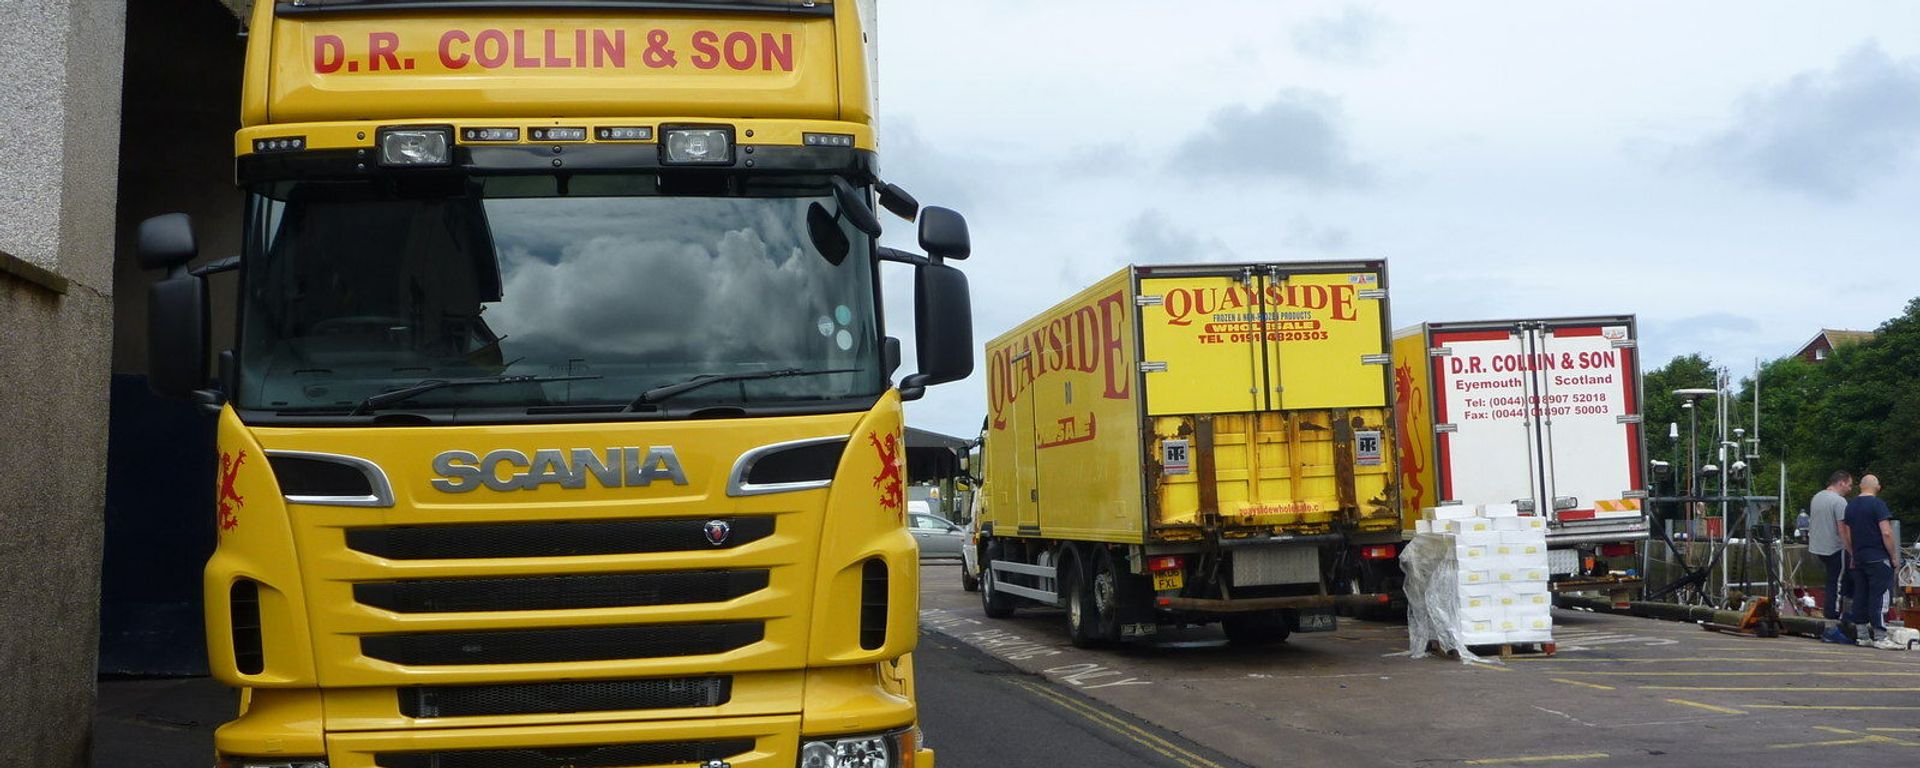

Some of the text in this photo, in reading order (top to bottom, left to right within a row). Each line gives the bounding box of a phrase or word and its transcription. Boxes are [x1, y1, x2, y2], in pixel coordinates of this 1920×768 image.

[438, 29, 626, 70] COLLIN
[642, 30, 678, 69] &
[690, 31, 794, 72] SON
[1164, 284, 1358, 326] QUAYSIDE
[1213, 313, 1236, 322] FROZEN
[1280, 311, 1312, 320] PRODUCTS
[1198, 331, 1329, 344] TEL 0191 4820303
[990, 289, 1130, 430] QUAYSIDE
[1492, 352, 1555, 373] COLLIN
[1560, 352, 1574, 370] &
[1579, 351, 1616, 369] SON
[1456, 374, 1612, 392] Eyemouth Scotland
[1465, 398, 1486, 408] Tel:
[1489, 395, 1526, 408] (0044)
[1572, 393, 1606, 403] 52018
[1464, 411, 1488, 420] Fax:
[1492, 408, 1527, 420] (0044)
[1574, 405, 1608, 415] 50003
[431, 445, 689, 494] SCANIA
[1159, 579, 1178, 588] FXL
